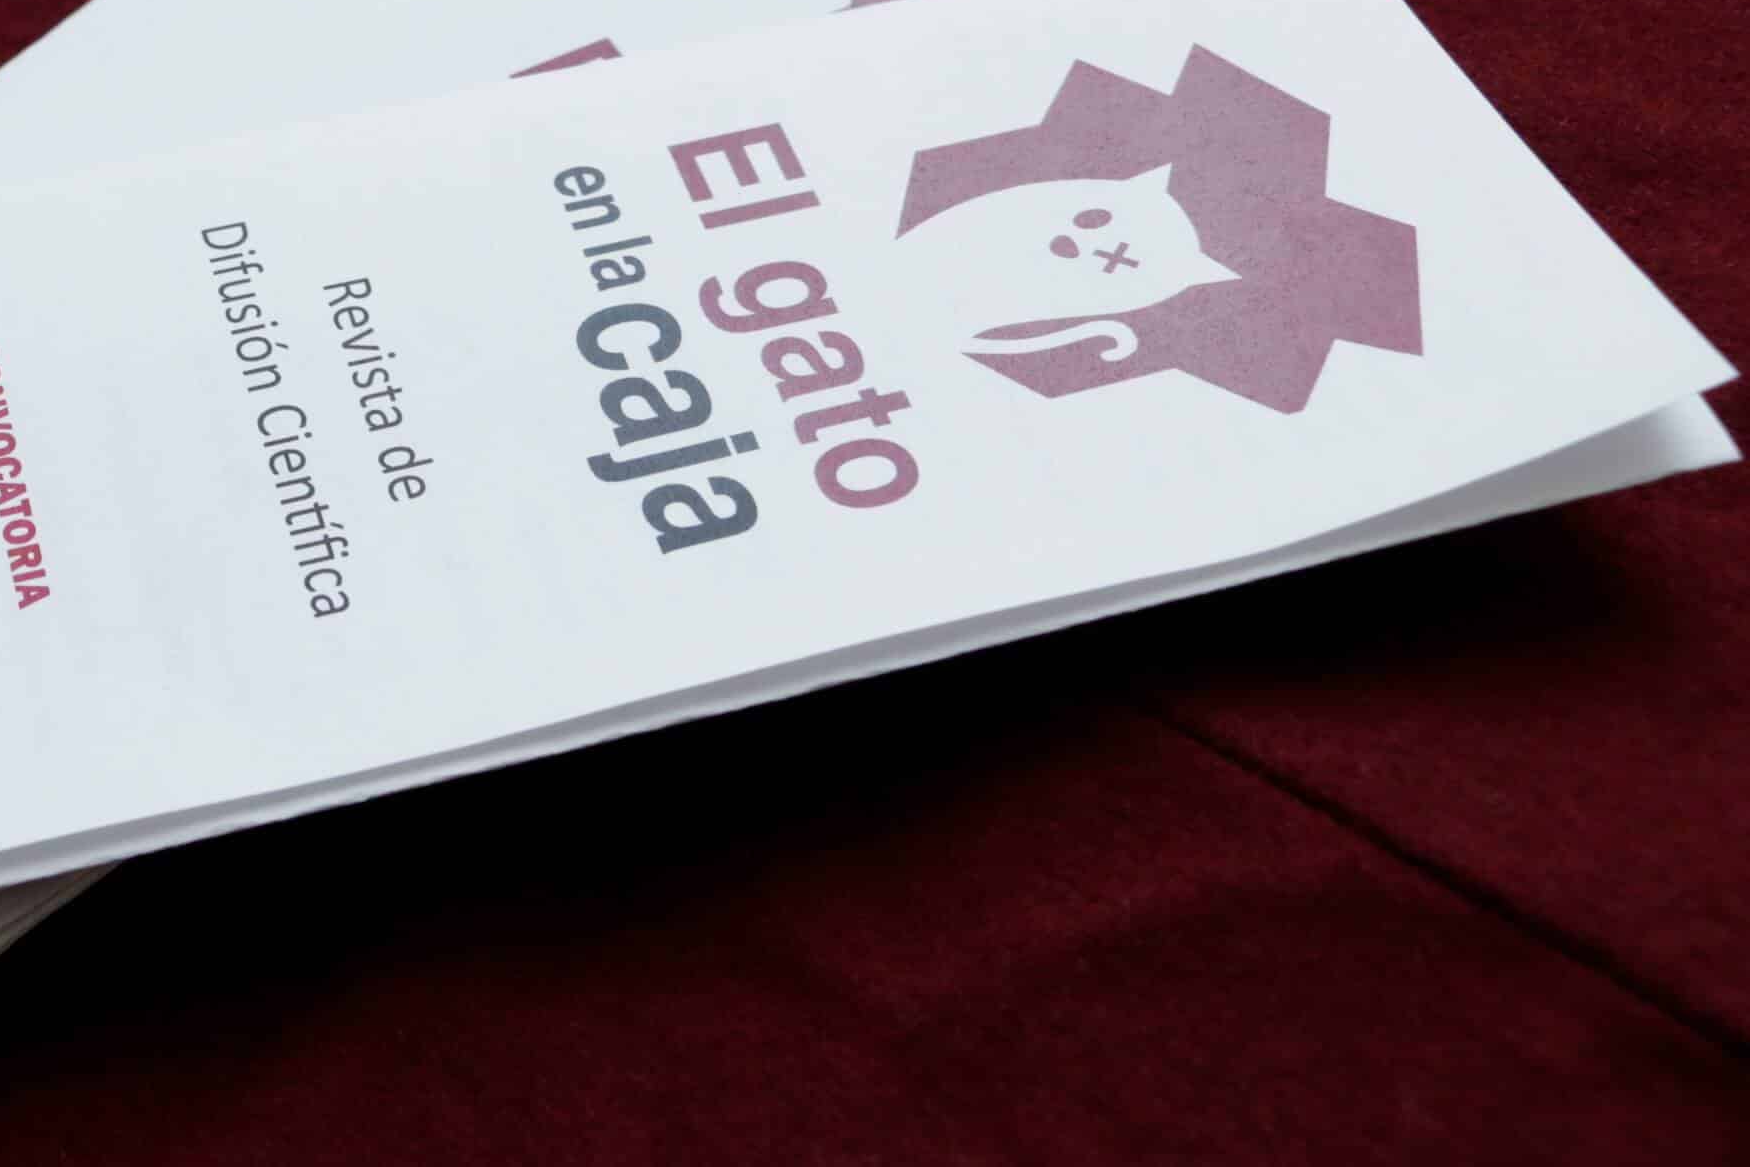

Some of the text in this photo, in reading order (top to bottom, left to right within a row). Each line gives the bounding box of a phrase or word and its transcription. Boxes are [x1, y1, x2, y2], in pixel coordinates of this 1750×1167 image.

[201, 221, 350, 618] Difusión Científica
[323, 277, 434, 503] Revista de
[554, 165, 759, 555] en la caja
[669, 123, 920, 509] El gato
